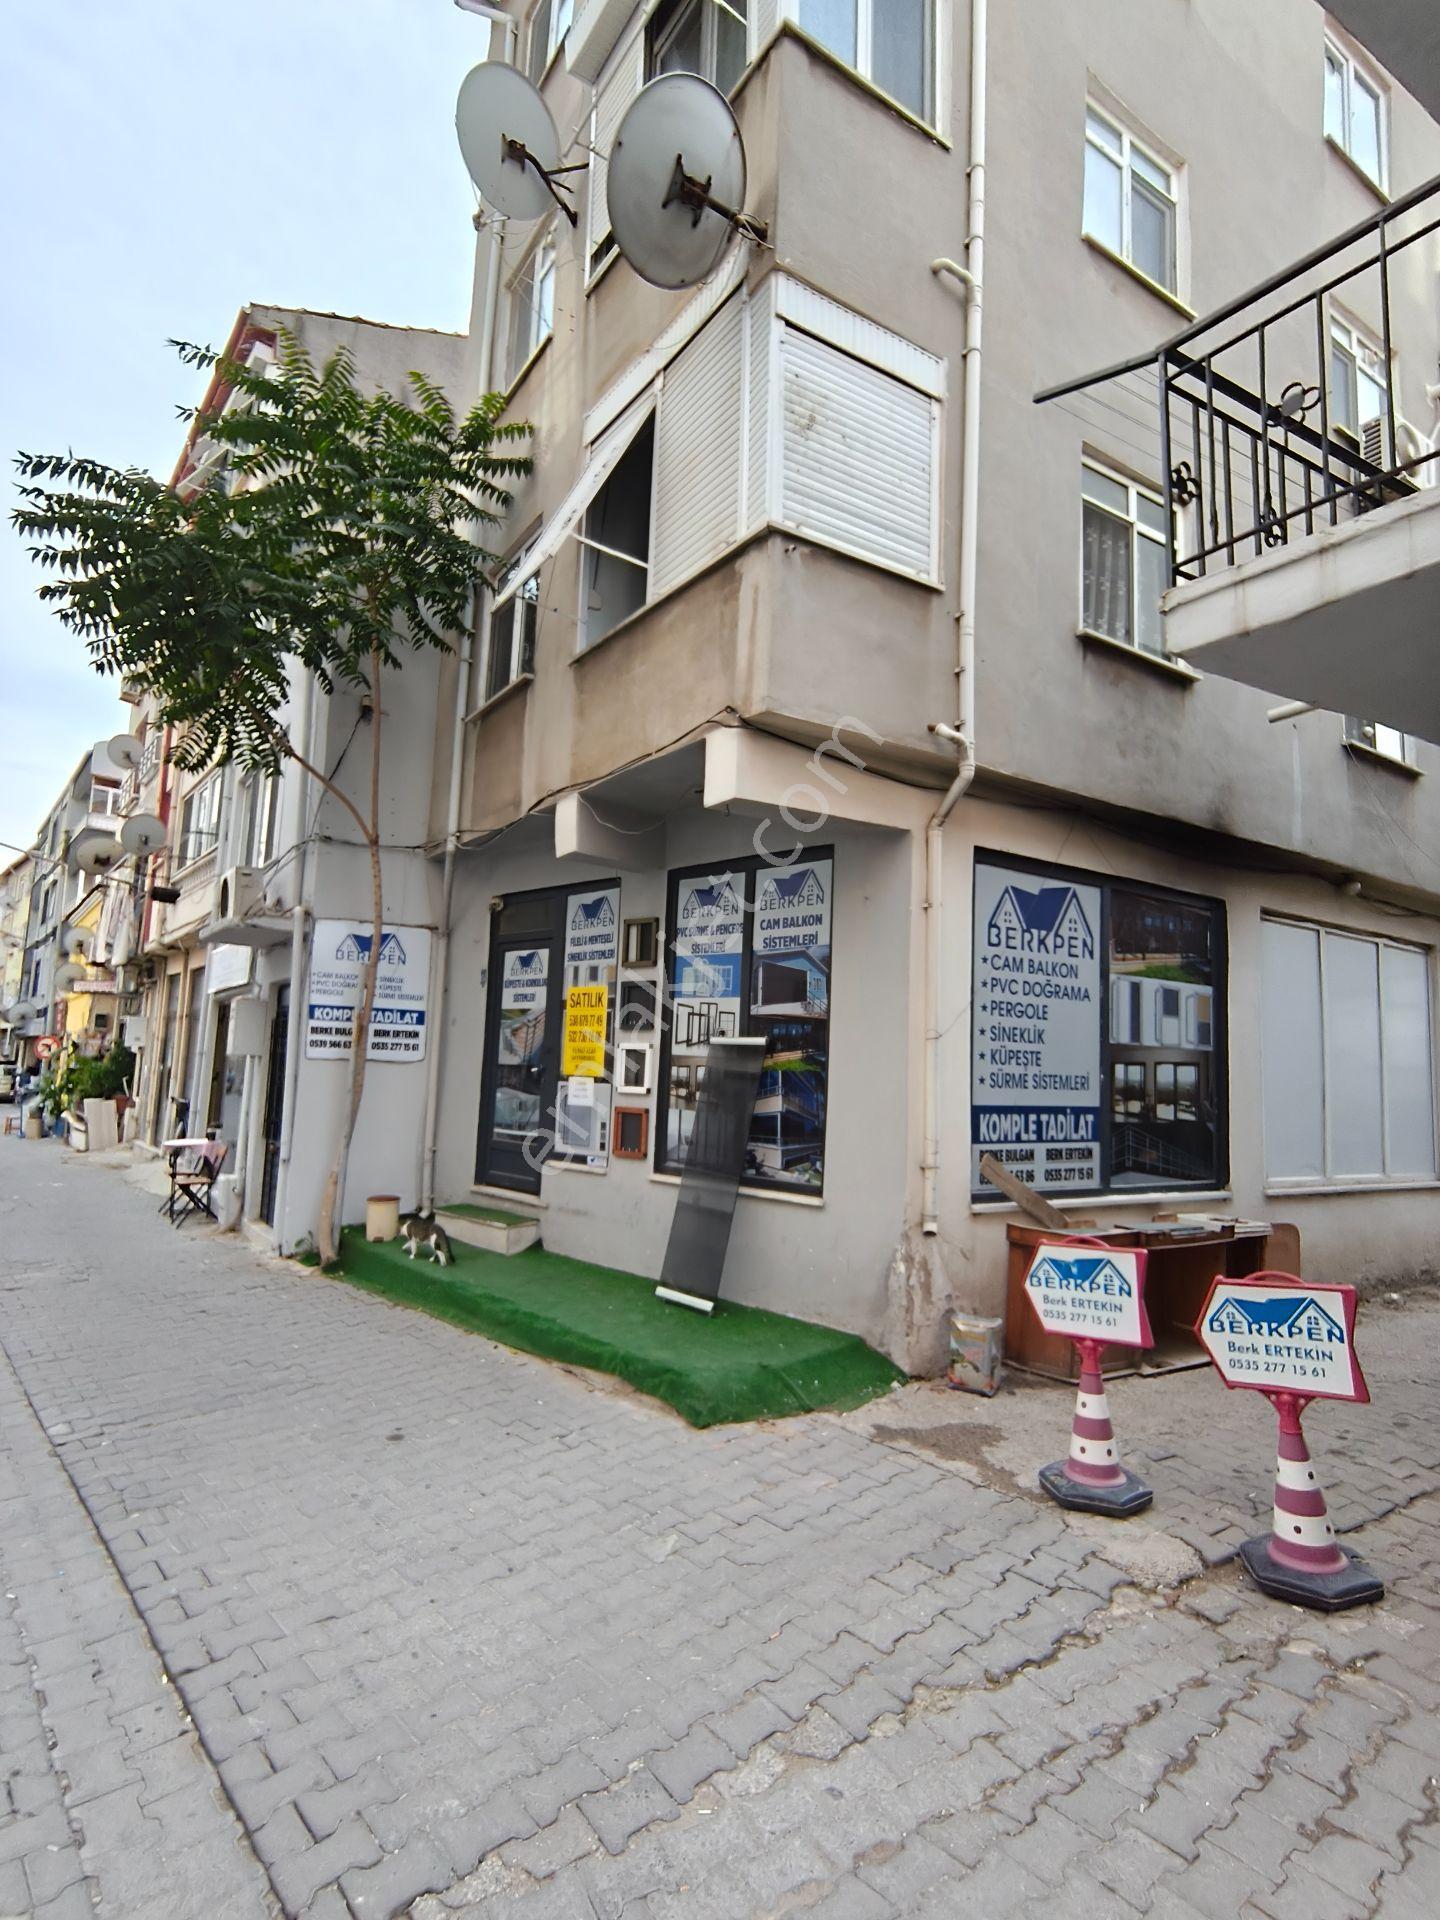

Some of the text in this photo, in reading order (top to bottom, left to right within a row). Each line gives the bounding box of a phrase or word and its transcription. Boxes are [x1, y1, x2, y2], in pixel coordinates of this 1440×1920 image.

[760, 893, 824, 911] BERKPEN
[572, 917, 614, 931] BERKPEN
[760, 914, 822, 930] CAM BALKON
[763, 931, 818, 949] SİSTEMLERİ
[987, 922, 1094, 960] BERKPEN
[990, 954, 1078, 979] CAM BALKON
[990, 977, 1091, 1002] PVC DOĞRAMA
[570, 992, 604, 1008] SATILIK
[314, 1007, 353, 1022] KOMP
[990, 1000, 1048, 1020] PERGOLE
[311, 1026, 353, 1037] BERKE BULG
[373, 1028, 391, 1038] BERK
[990, 1022, 1045, 1044] SİNEKLİK
[390, 1042, 403, 1051] 277
[990, 1045, 1041, 1071] KÜPEŞTE
[989, 1069, 1090, 1091] SÜRME SİSTEMLERİ
[979, 1109, 1094, 1141] KOMPLE TADİLAT
[1005, 1149, 1035, 1162] BULGAN
[1046, 1145, 1093, 1162] BERK ERTEKİN
[1044, 1168, 1063, 1182] 0535
[1063, 1167, 1076, 1182] 277
[1078, 1167, 1086, 1181] 15
[1030, 1275, 1132, 1298] BERKPEN
[1043, 1294, 1067, 1307] Berk
[1043, 1309, 1117, 1327] 0535 277 15 61
[1209, 1319, 1344, 1344] BERKPEN
[1228, 1341, 1334, 1362] Berk ERTEKİN
[1229, 1358, 1326, 1378] 0535 277 15 61
